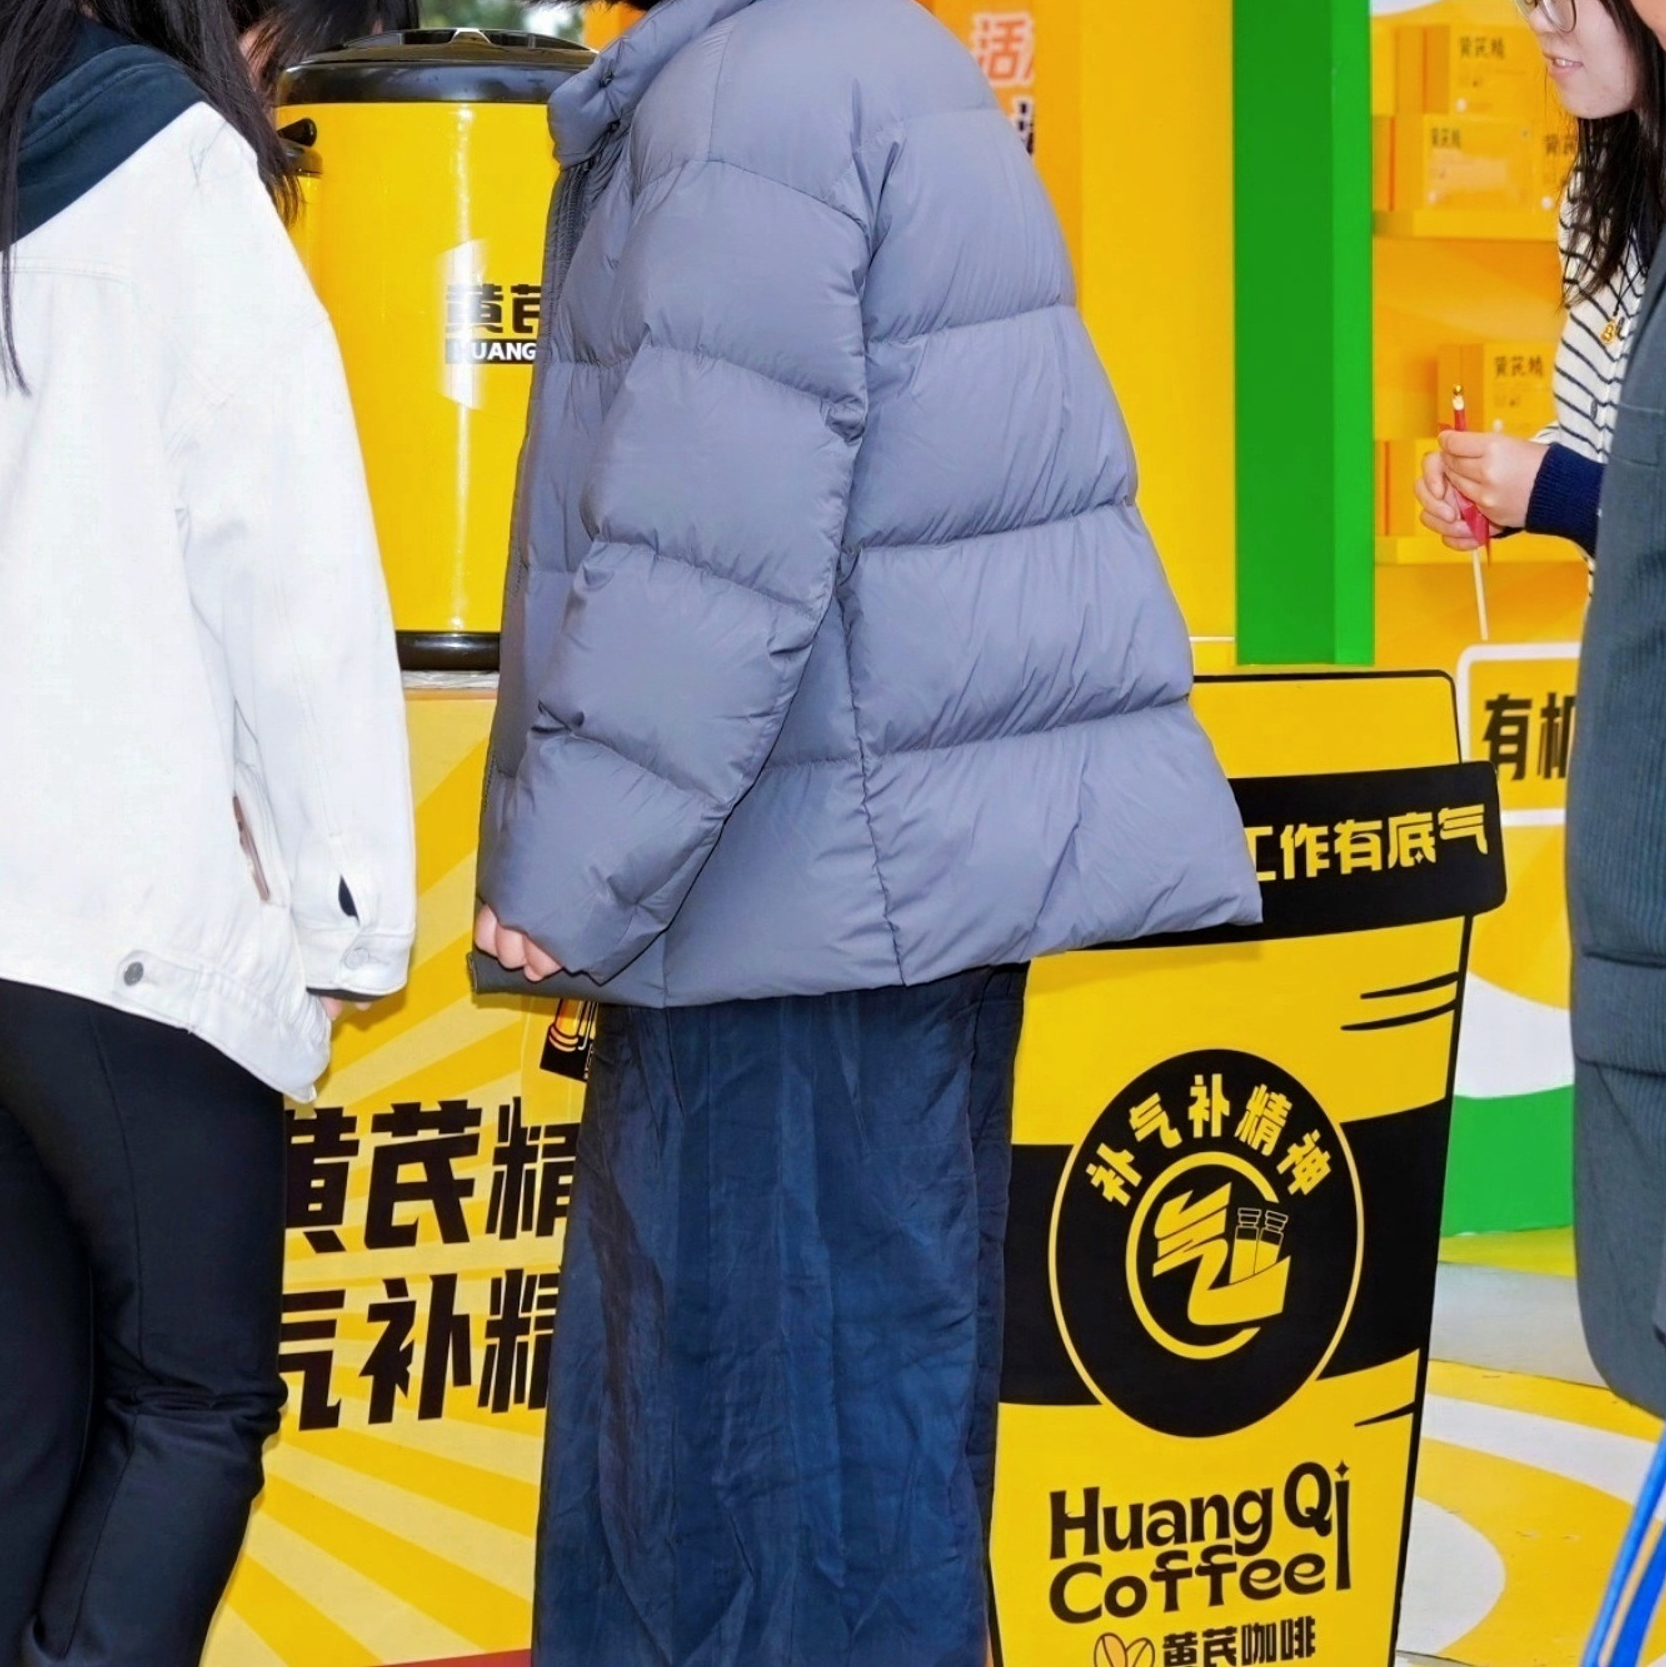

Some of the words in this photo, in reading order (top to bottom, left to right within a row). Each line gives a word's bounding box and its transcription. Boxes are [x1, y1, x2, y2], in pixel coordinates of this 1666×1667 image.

[978, 17, 1033, 80] 活
[451, 341, 537, 362] UANG
[1085, 1072, 1332, 1208] 补气补精神
[1049, 1485, 1274, 1561] Huang
[1283, 1459, 1352, 1591] Qi
[1048, 1543, 1326, 1625] Coffee
[1162, 1615, 1317, 1667] 黄芪咖啡
